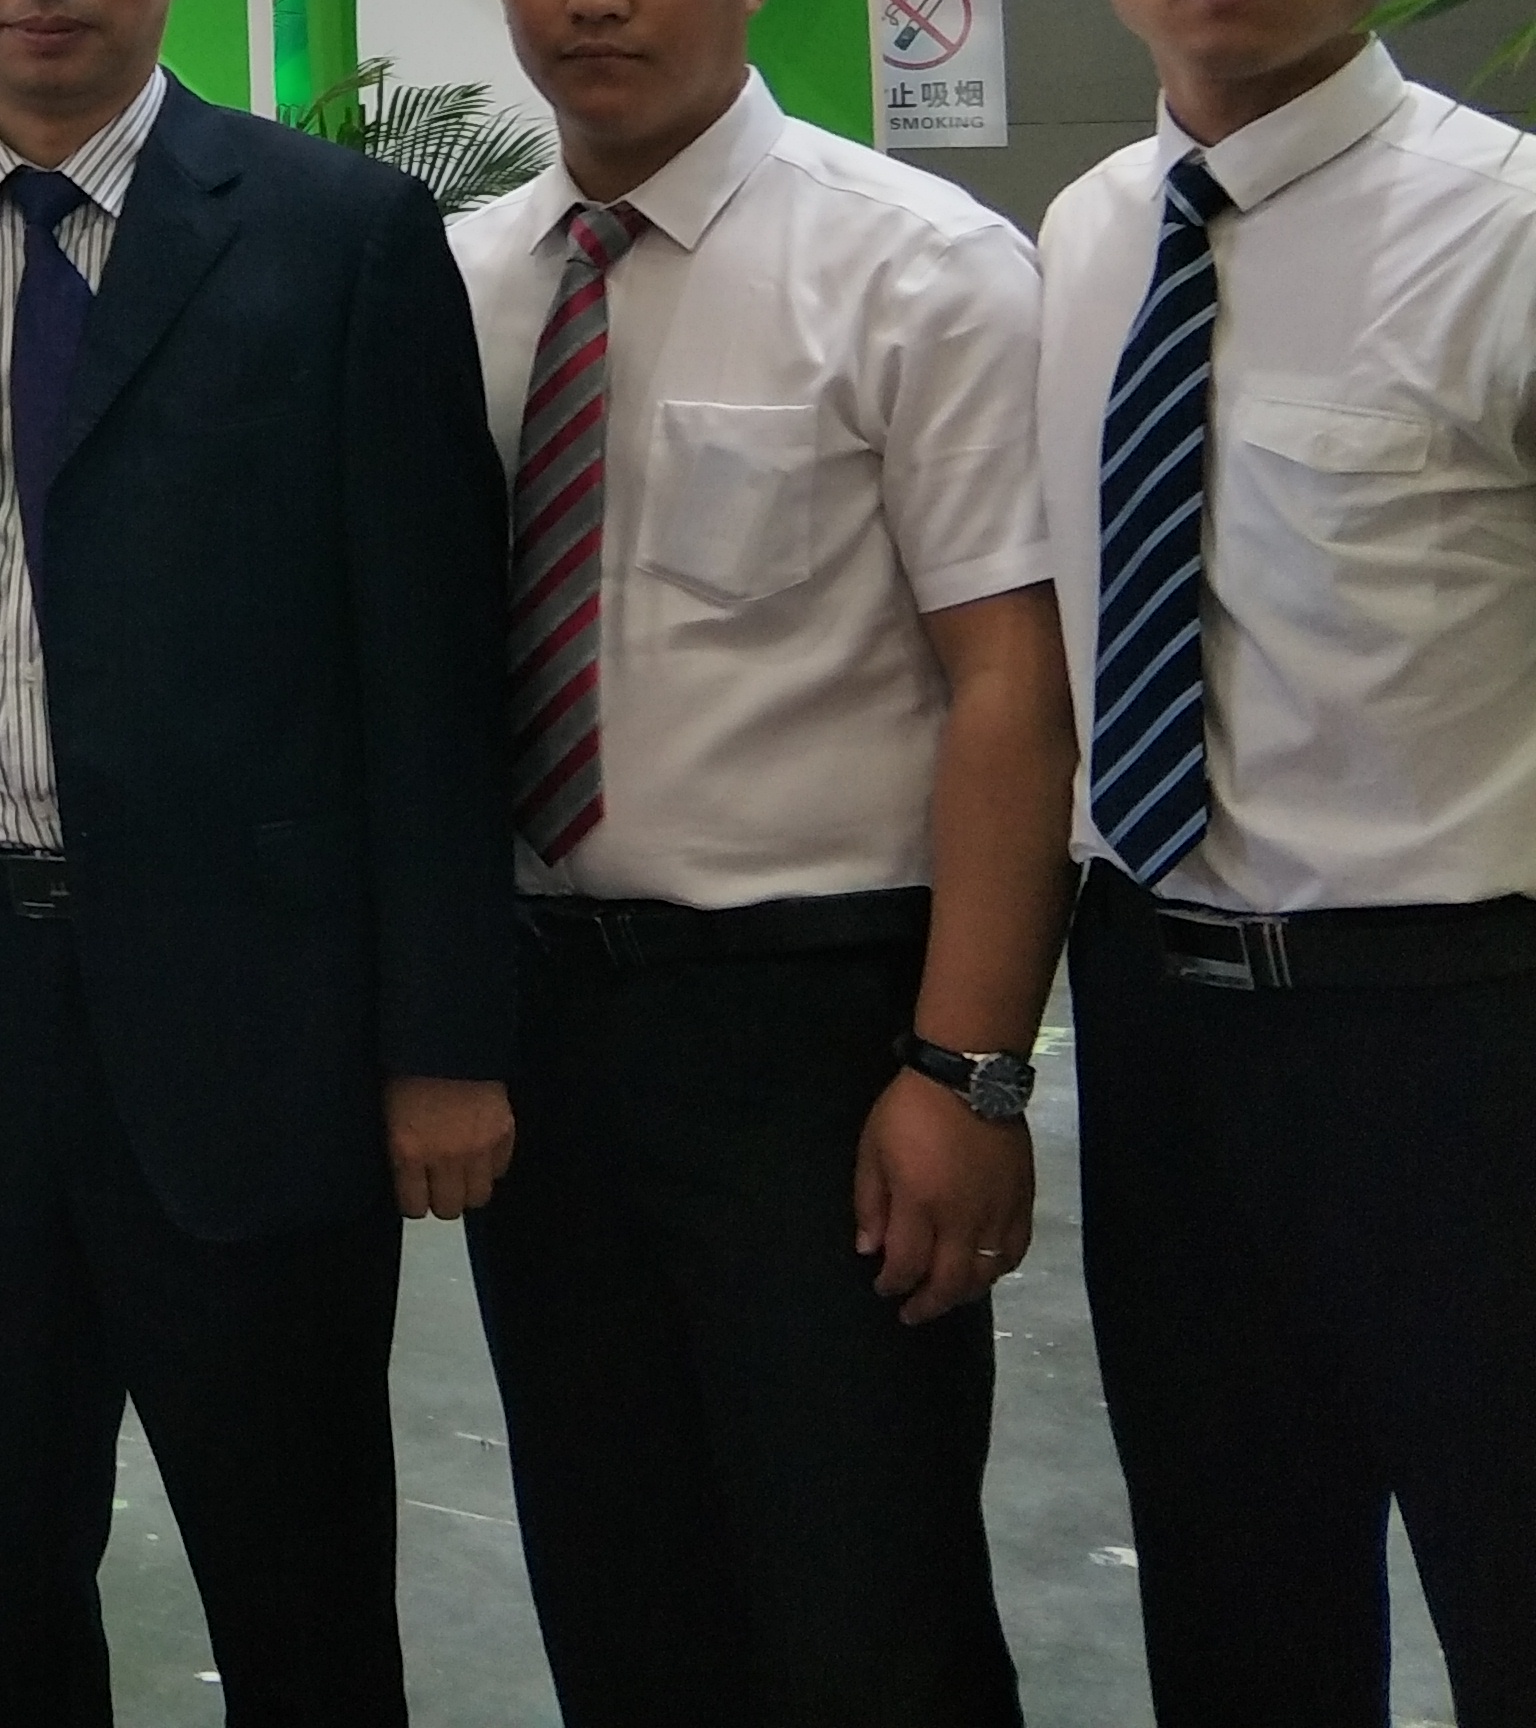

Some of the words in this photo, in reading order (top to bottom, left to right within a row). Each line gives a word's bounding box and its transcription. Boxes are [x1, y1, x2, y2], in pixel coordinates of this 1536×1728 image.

[886, 80, 984, 108] 止吸烟
[890, 116, 984, 130] SMOKING
